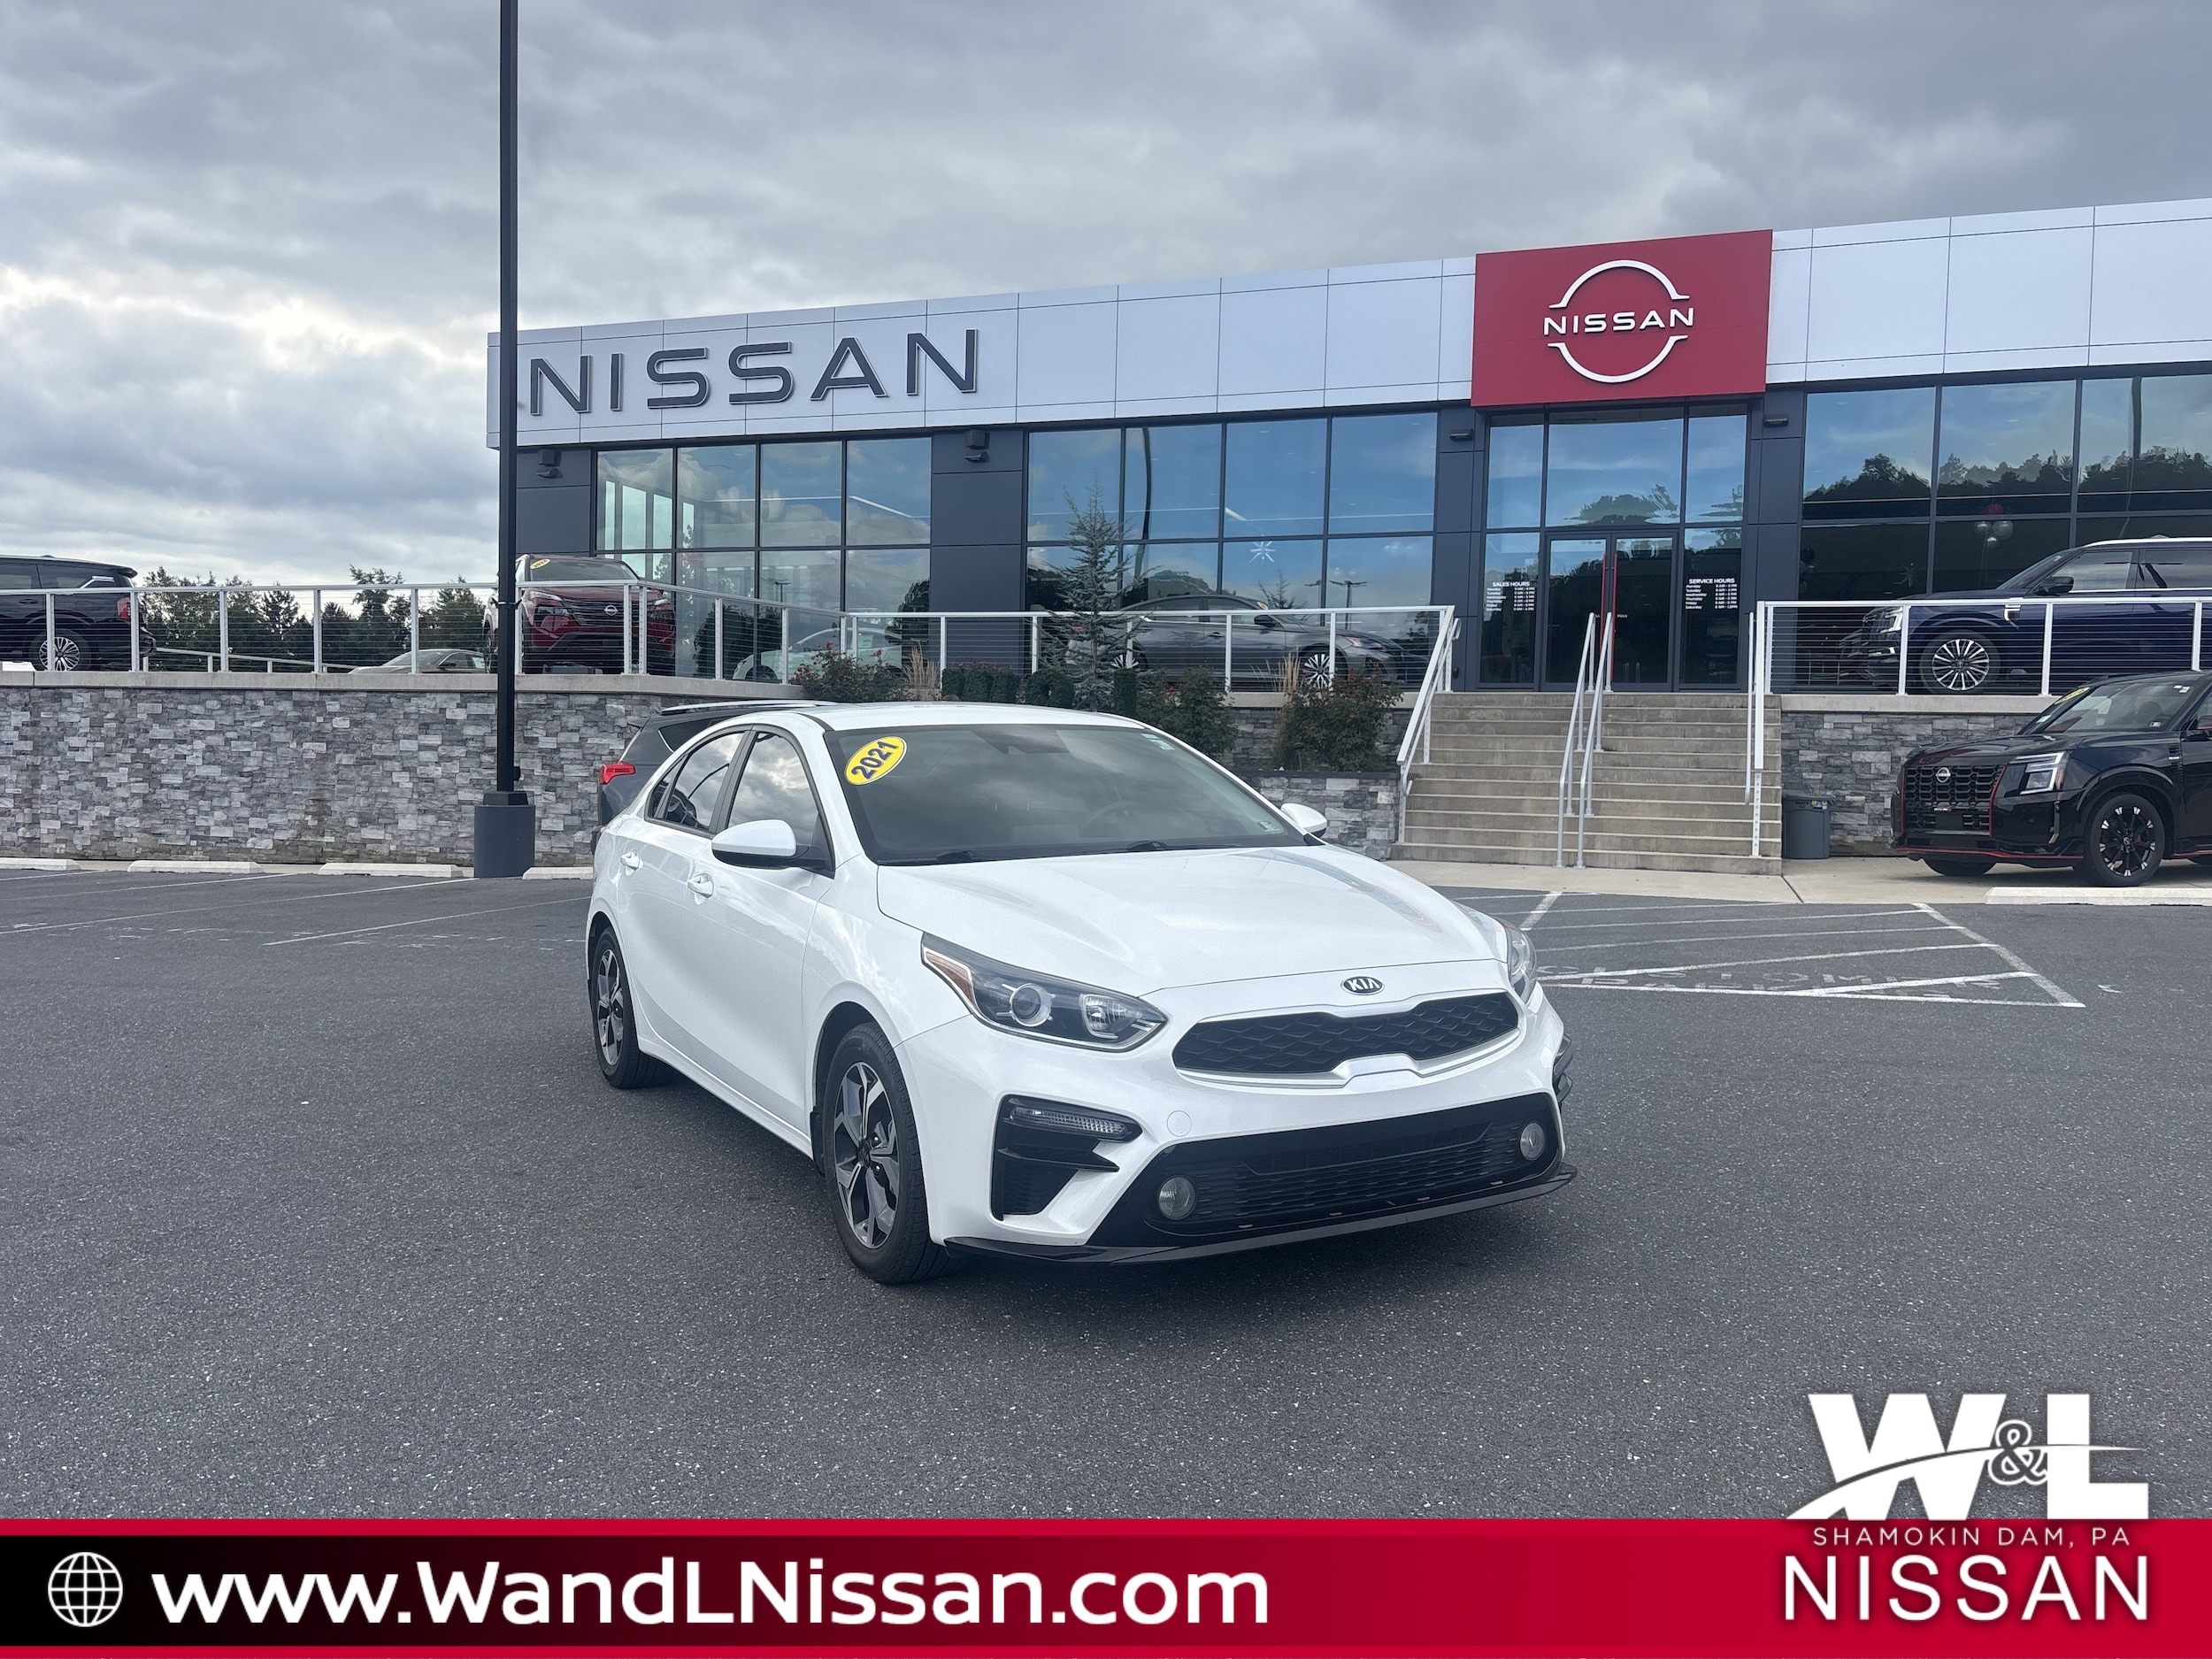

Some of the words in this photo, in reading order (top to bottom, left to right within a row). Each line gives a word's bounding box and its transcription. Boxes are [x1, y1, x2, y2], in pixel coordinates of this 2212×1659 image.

[1543, 307, 1694, 335] NISSAN
[530, 328, 978, 416] NISSAN
[851, 741, 899, 780] 2021
[1347, 978, 1380, 991] KIA
